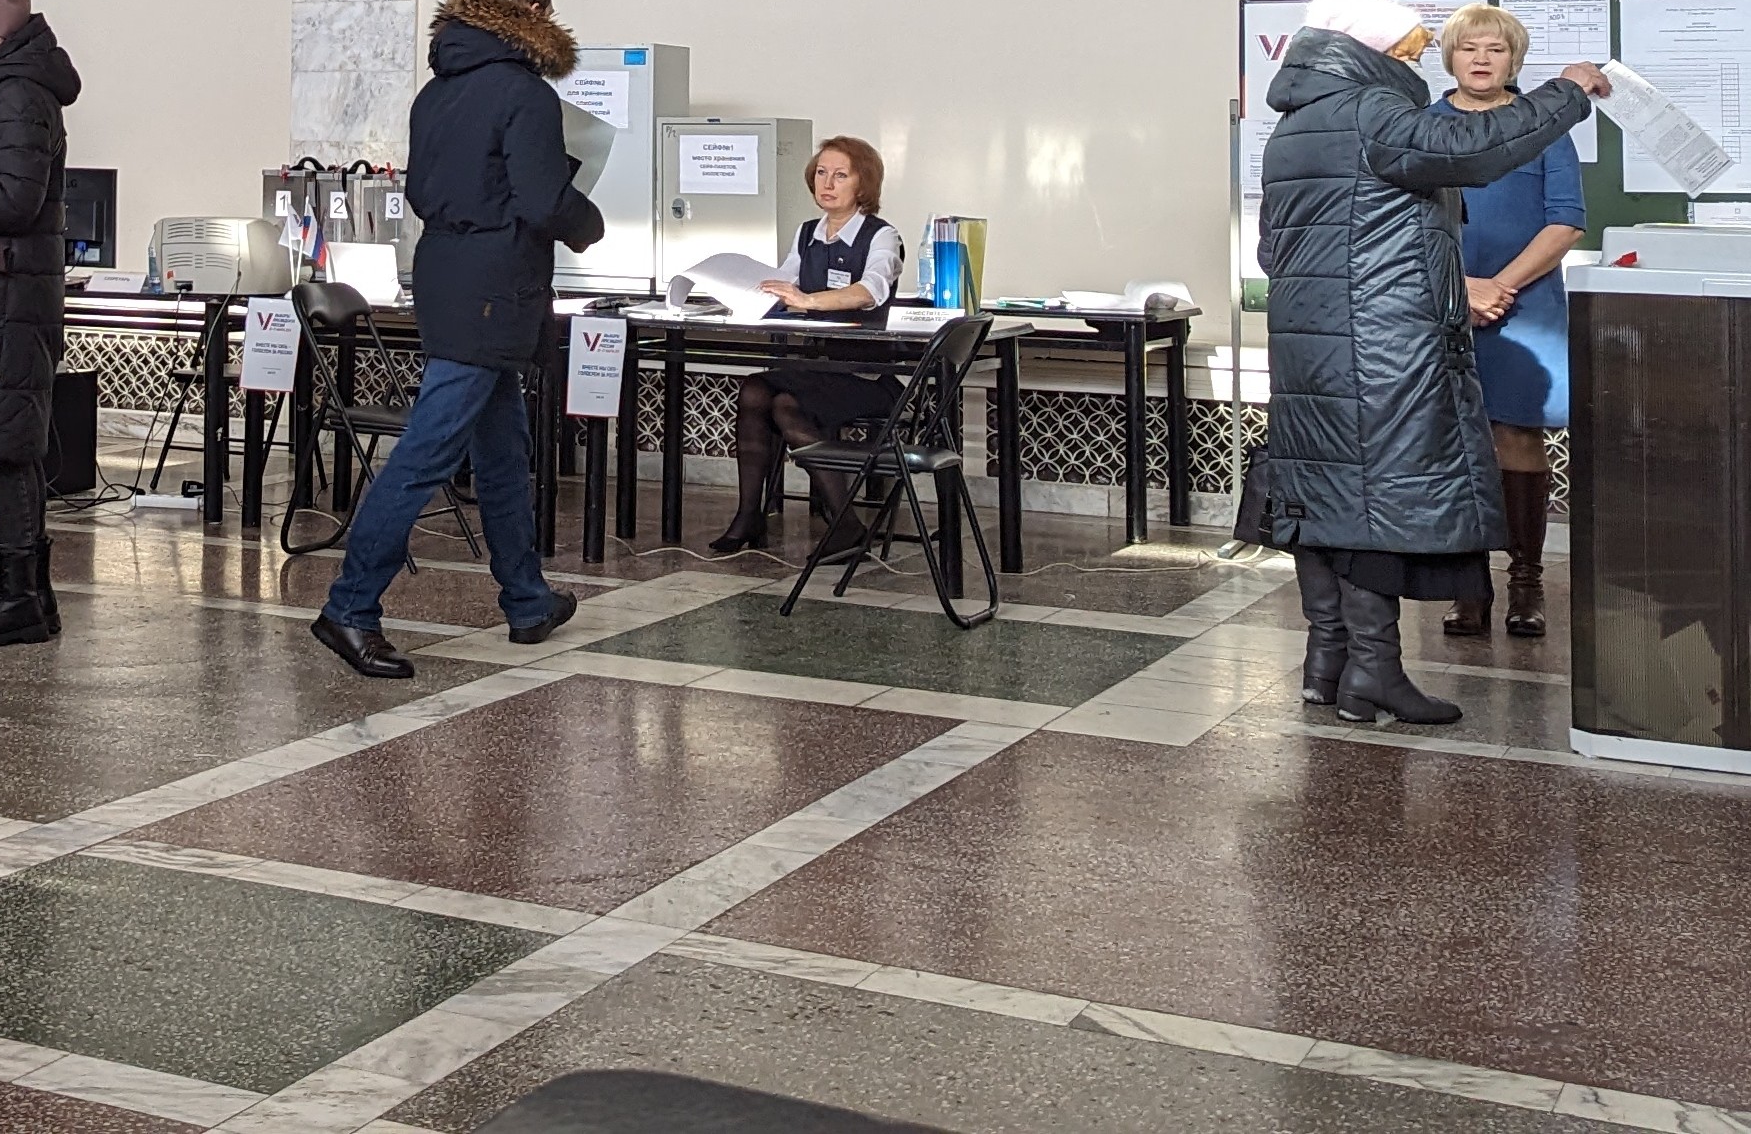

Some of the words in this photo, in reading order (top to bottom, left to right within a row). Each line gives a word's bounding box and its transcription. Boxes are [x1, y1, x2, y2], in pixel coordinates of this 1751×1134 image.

[279, 194, 286, 211] 1
[333, 197, 344, 214] 2
[389, 197, 401, 215] 3
